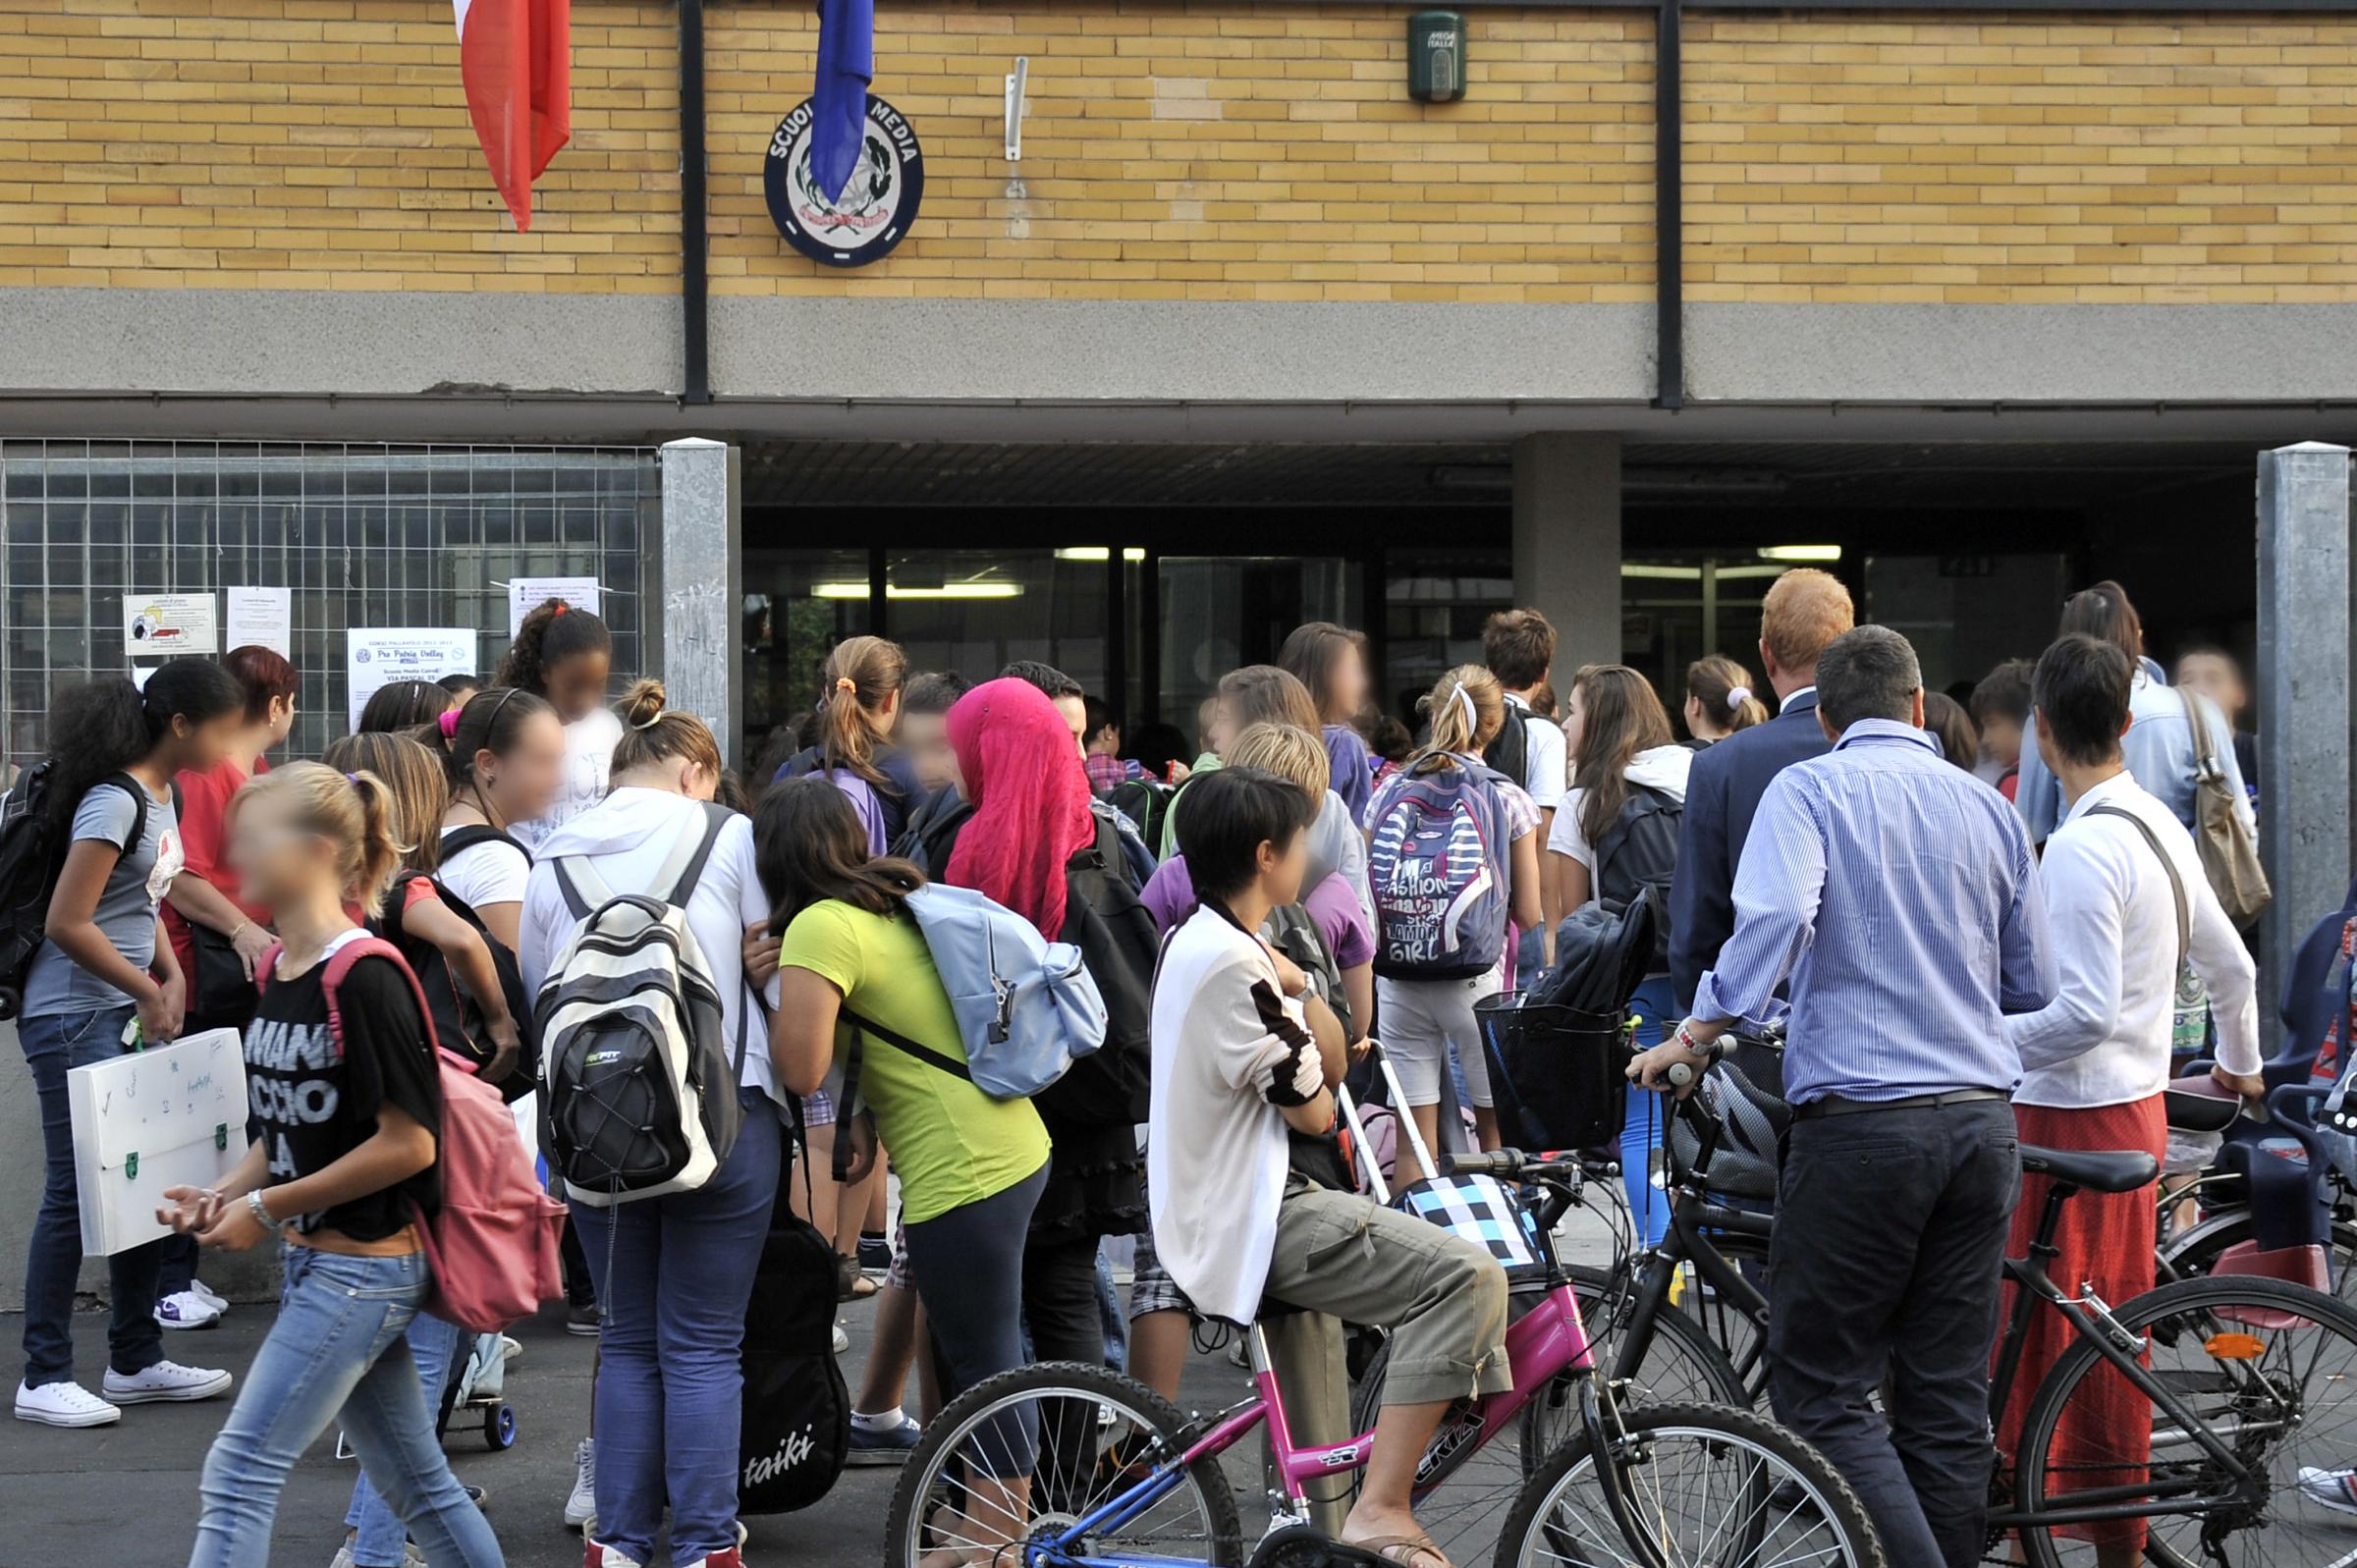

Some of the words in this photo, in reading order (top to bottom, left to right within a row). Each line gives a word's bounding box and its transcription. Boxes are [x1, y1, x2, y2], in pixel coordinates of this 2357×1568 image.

[1427, 40, 1454, 49] ITALIA
[1429, 30, 1455, 40] MEGA
[870, 101, 918, 163] MEDIA
[1383, 873, 1449, 897] ASHION
[1389, 937, 1440, 964] GIRL
[743, 1423, 816, 1489] taiki
